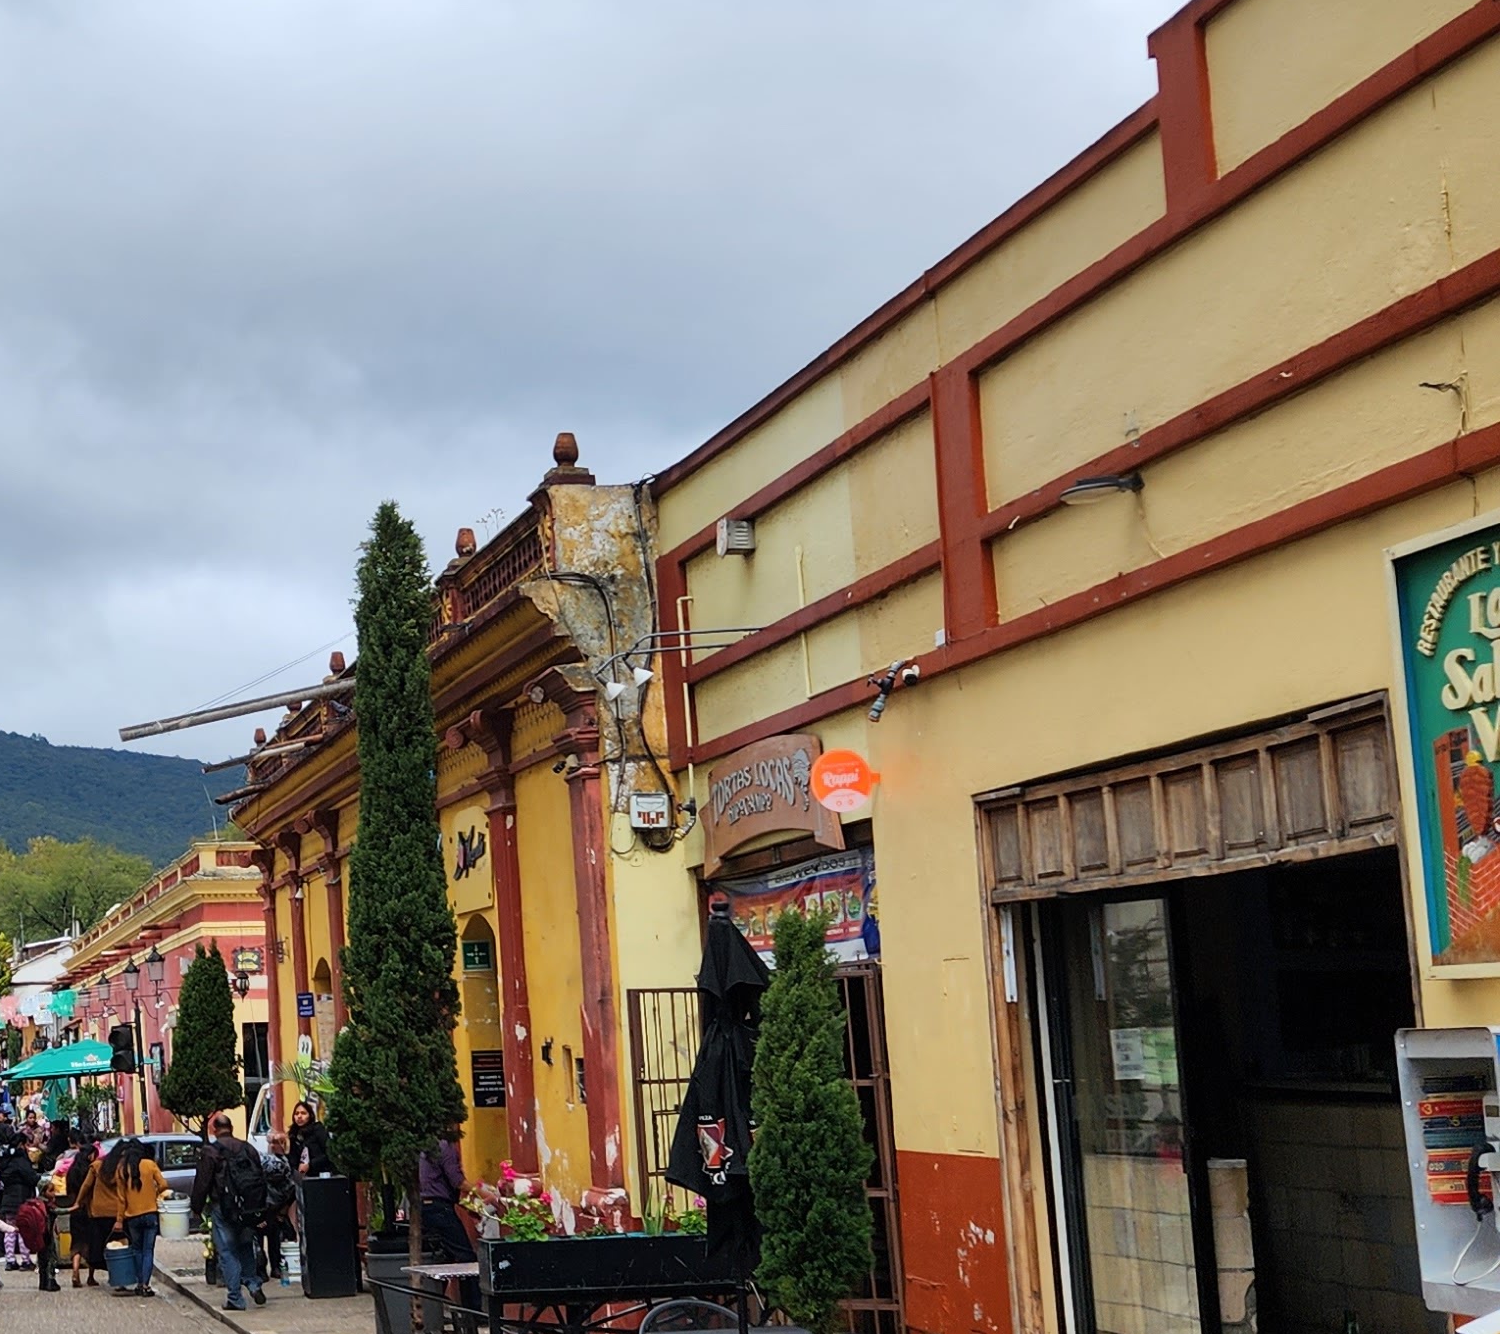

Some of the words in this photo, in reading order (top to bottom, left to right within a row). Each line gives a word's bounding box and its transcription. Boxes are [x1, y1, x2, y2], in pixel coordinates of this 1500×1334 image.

[1417, 546, 1492, 657] RESTAURANTE
[712, 767, 752, 825] TORTAS
[755, 756, 795, 806] LOCAS
[821, 768, 859, 788] Rappi
